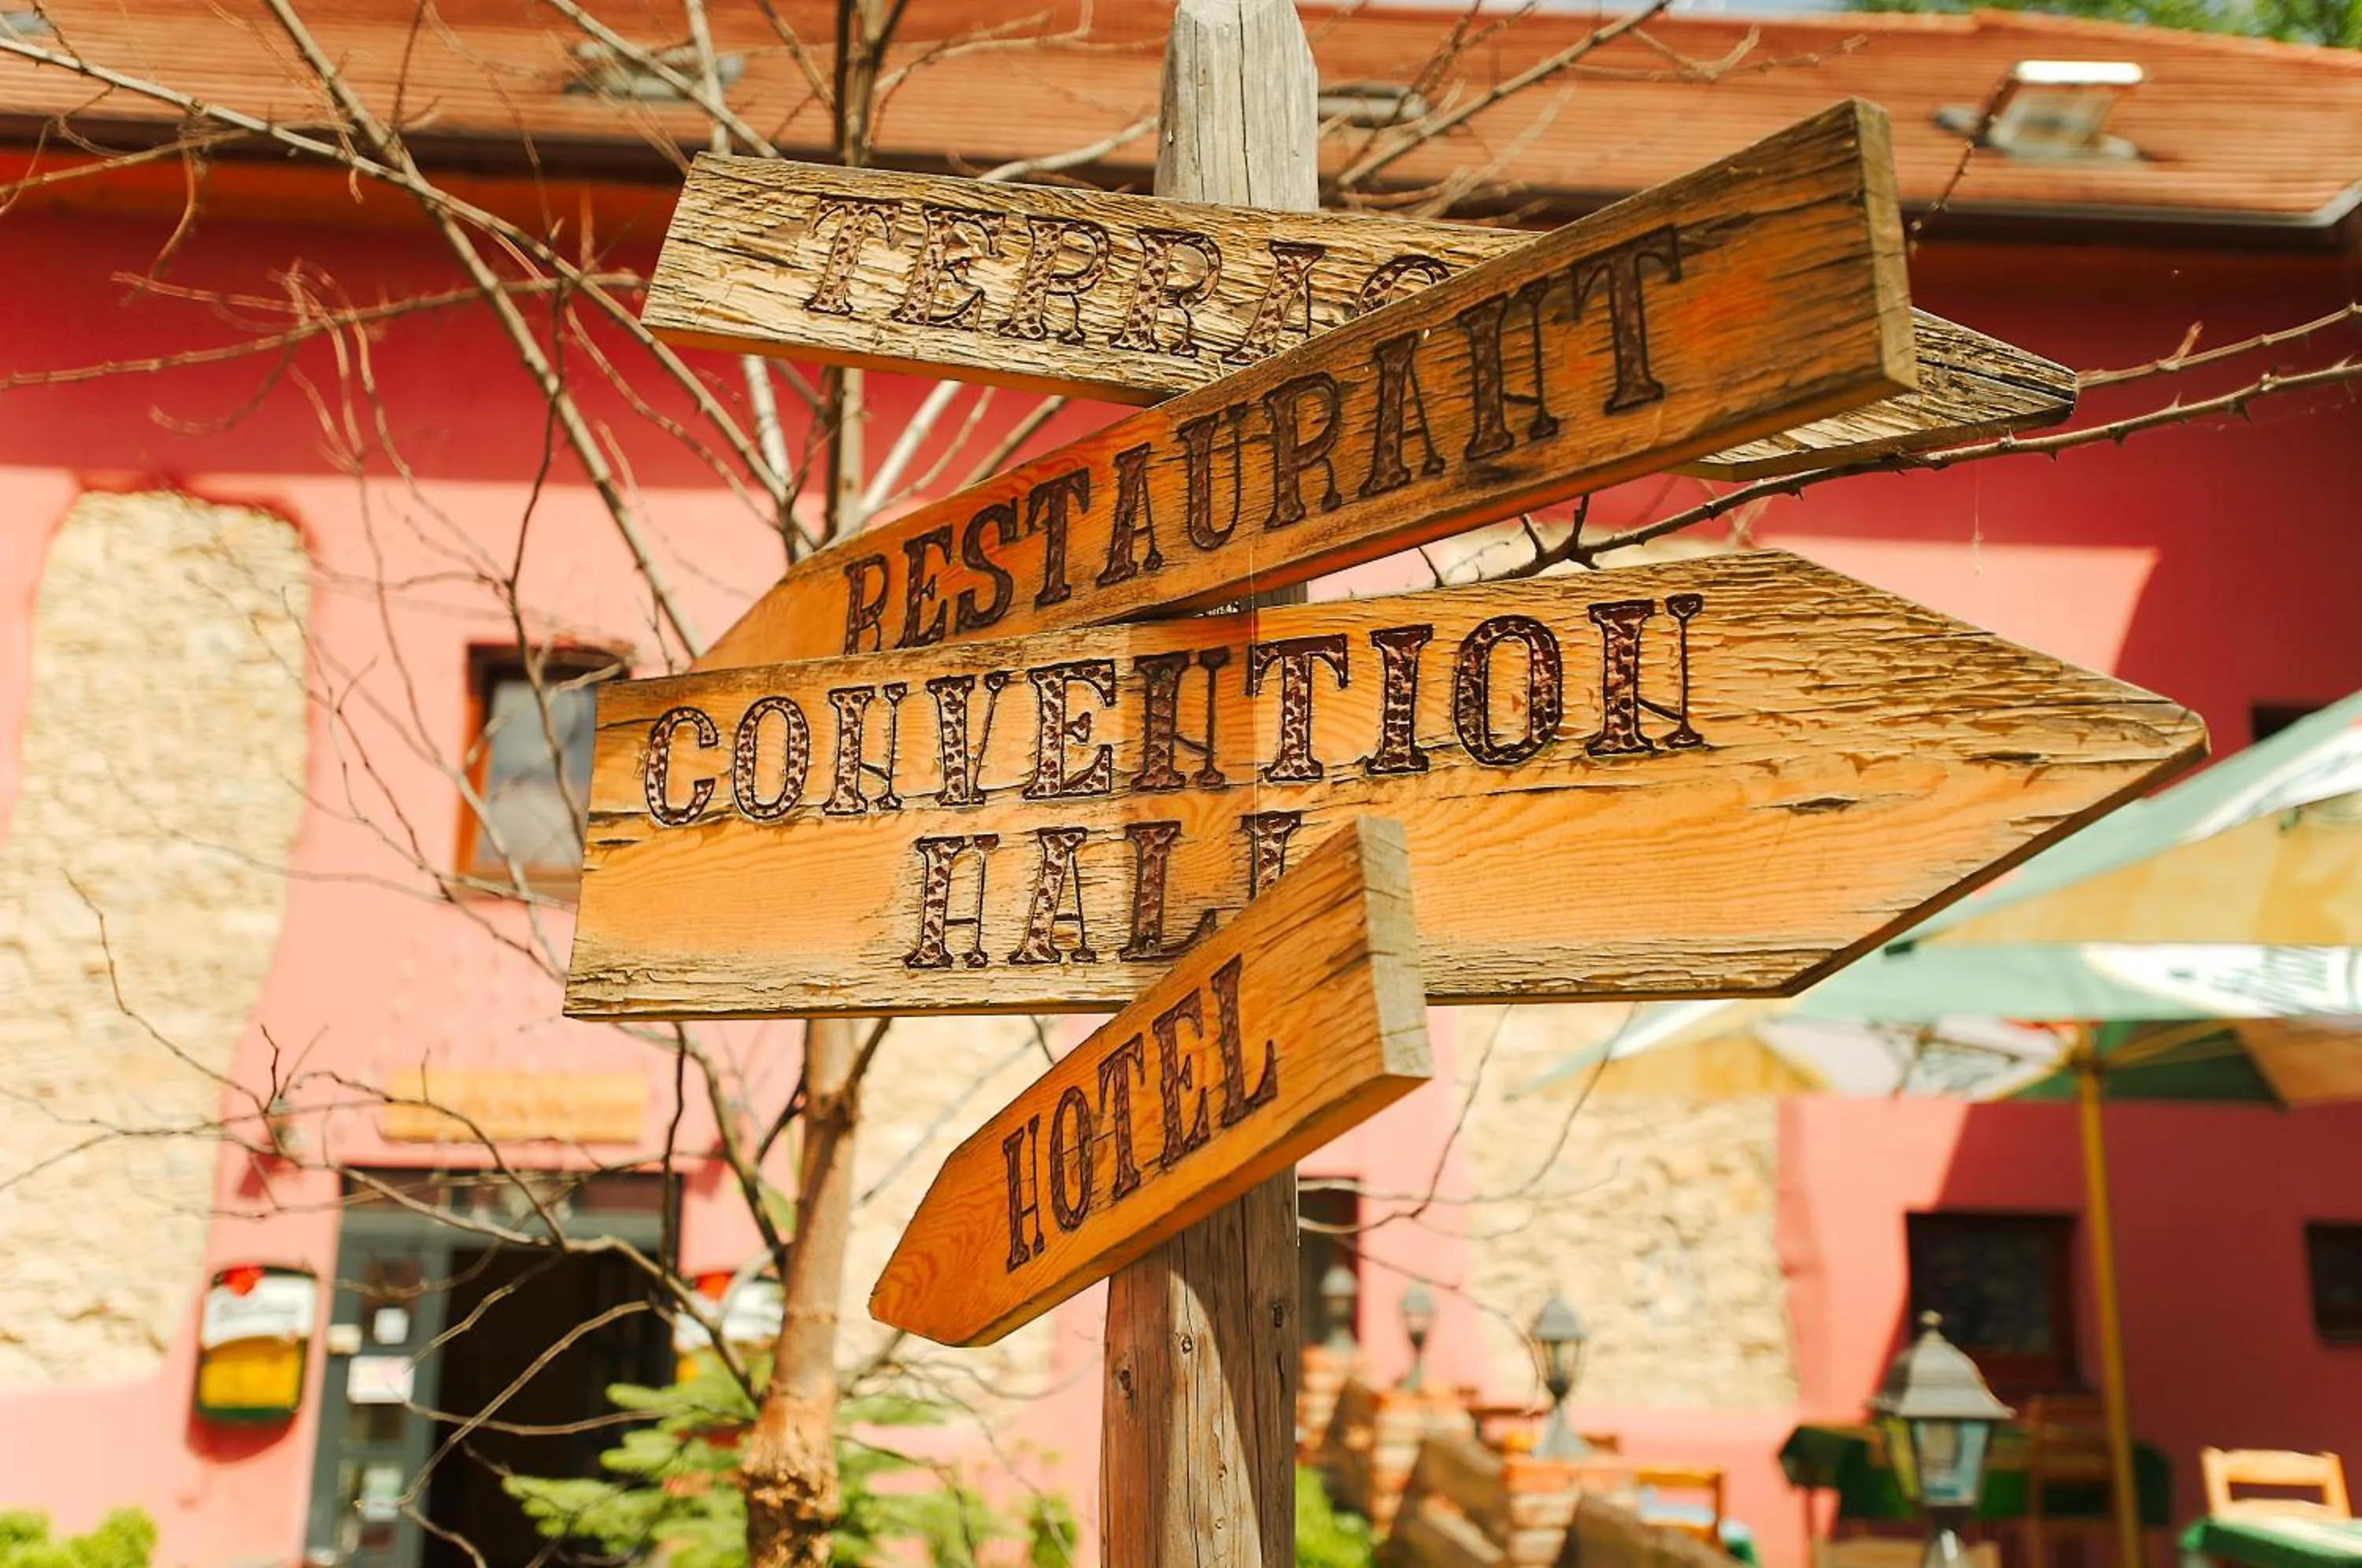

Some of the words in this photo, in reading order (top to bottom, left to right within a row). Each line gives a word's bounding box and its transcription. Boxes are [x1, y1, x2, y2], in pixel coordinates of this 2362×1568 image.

[842, 224, 1681, 656] RESTAURANT
[644, 593, 1705, 827] CONVENTION
[1003, 955, 1277, 1271] HOTEL
